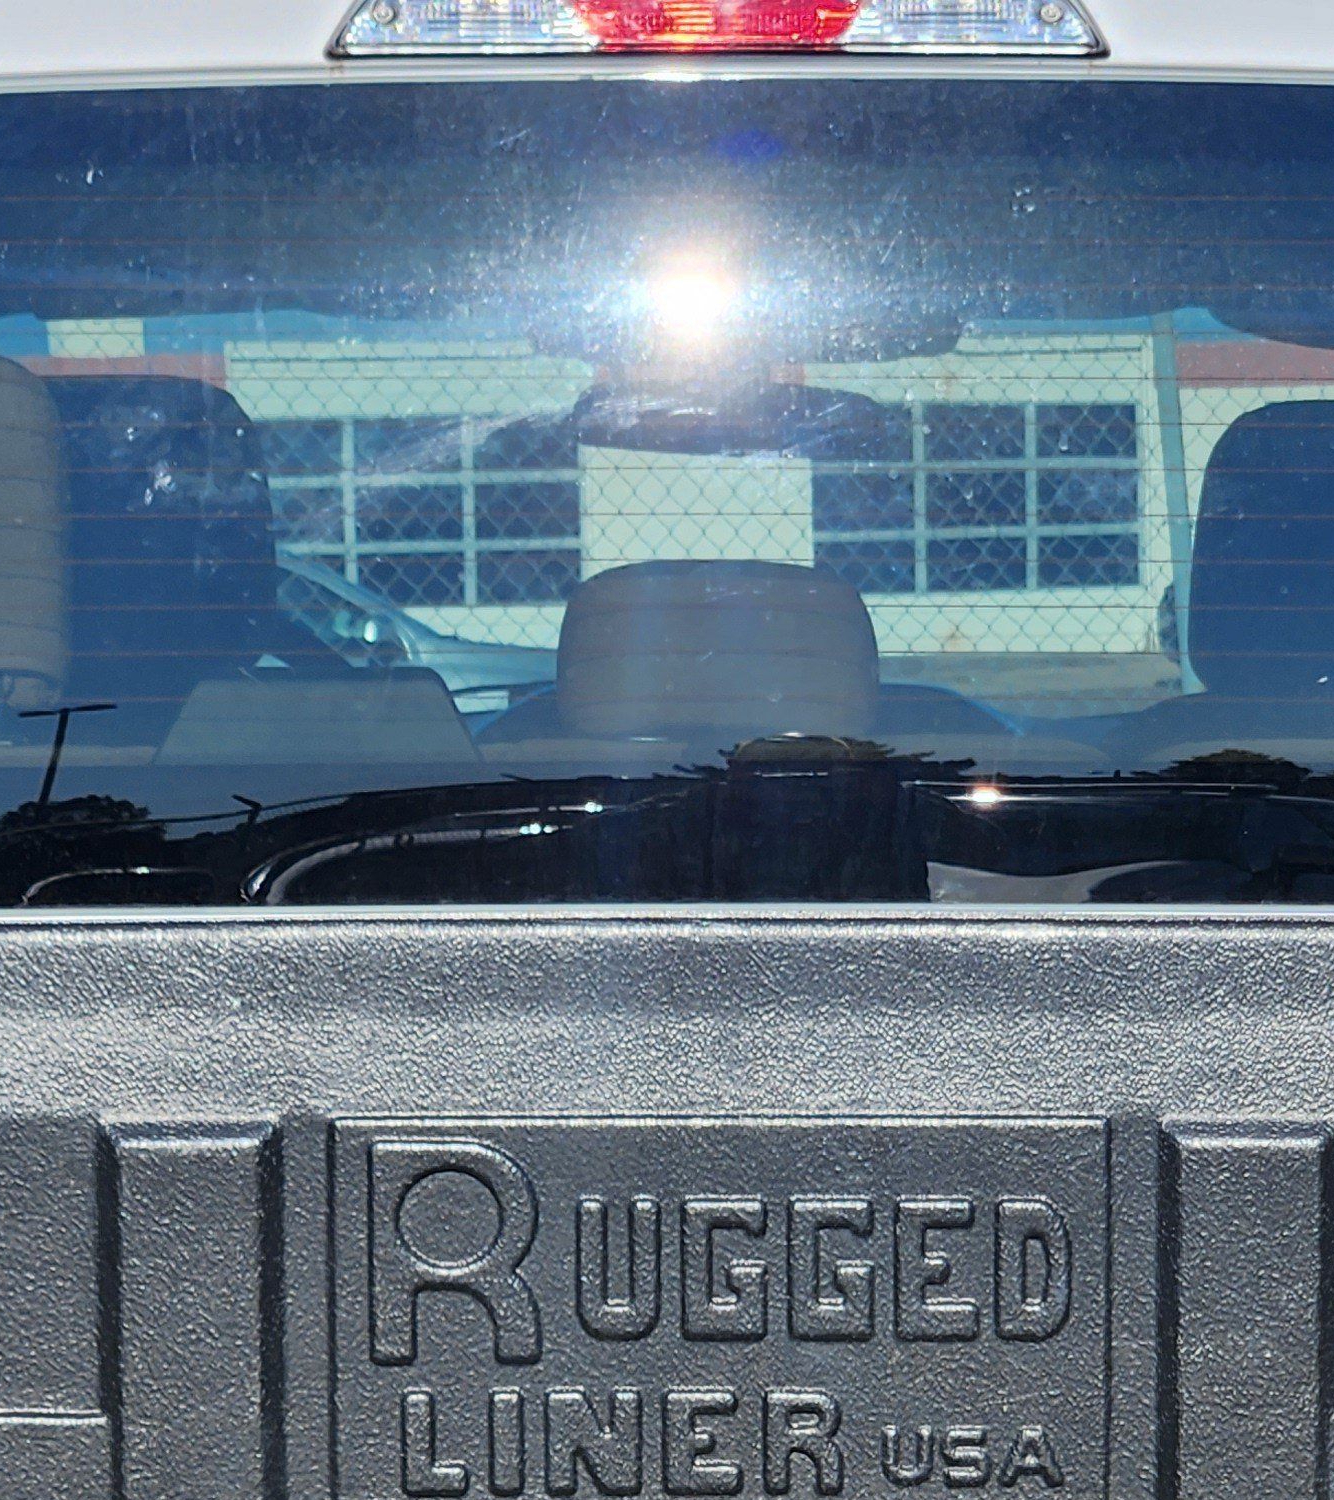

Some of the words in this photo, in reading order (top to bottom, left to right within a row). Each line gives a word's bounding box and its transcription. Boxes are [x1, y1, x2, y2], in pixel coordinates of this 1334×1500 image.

[369, 1139, 1073, 1366] RUGGED
[399, 1387, 845, 1498] LINER
[881, 1424, 1066, 1490] USA
